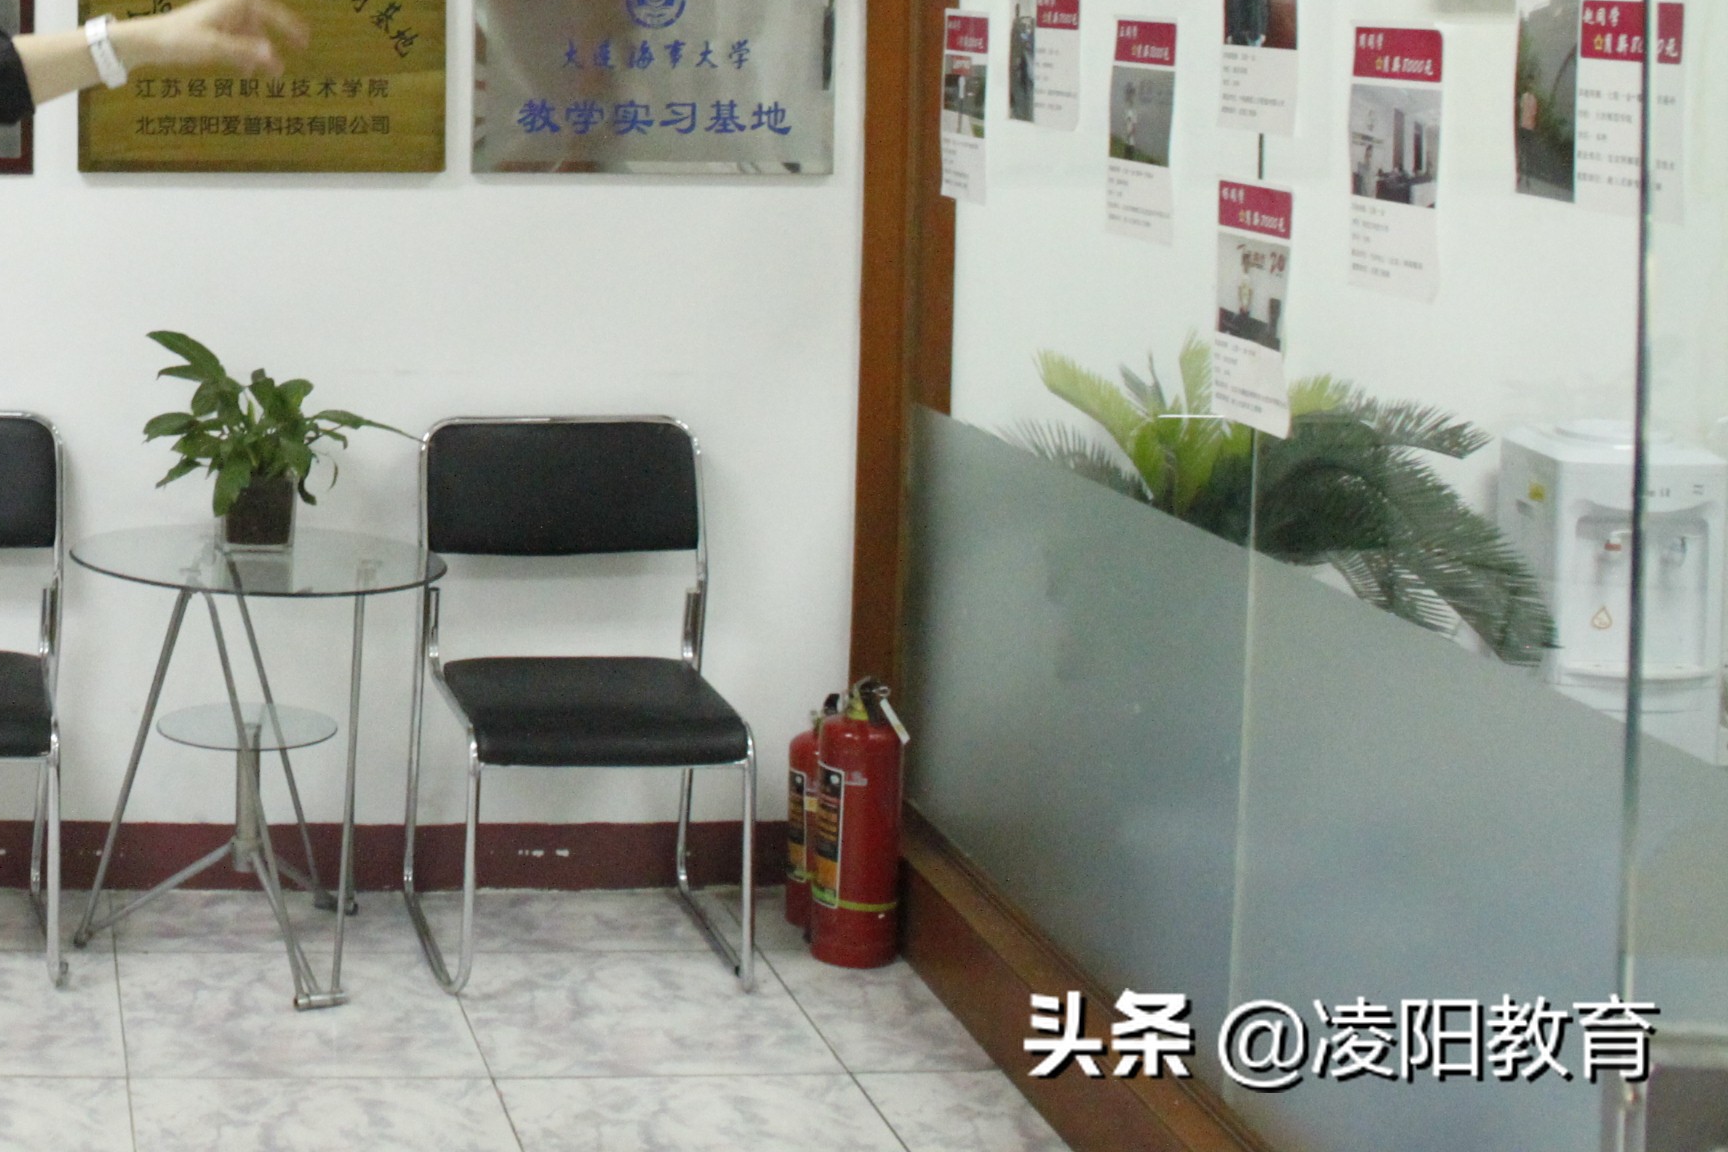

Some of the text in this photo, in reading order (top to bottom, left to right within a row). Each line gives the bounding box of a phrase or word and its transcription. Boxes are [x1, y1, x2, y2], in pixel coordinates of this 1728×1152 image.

[135, 78, 390, 100] 江苏经贸职业技术学院
[135, 114, 391, 137] 北京凌阳爱普科技有限公司
[516, 98, 793, 136] 教学实习基地
